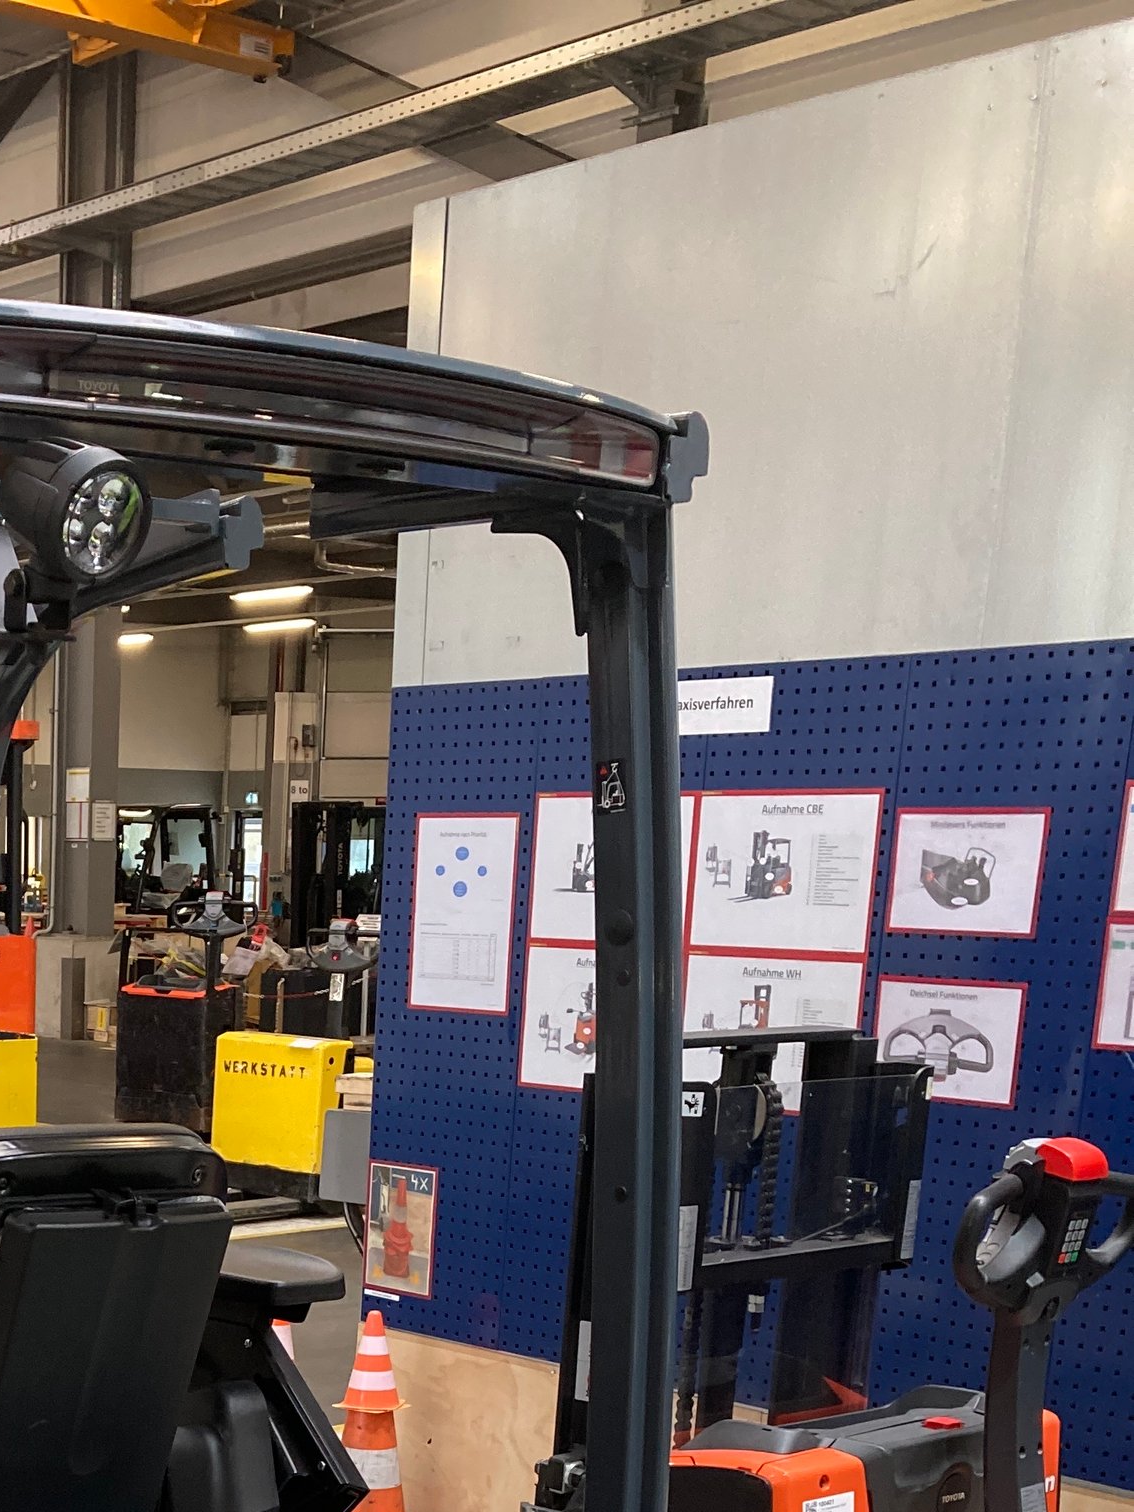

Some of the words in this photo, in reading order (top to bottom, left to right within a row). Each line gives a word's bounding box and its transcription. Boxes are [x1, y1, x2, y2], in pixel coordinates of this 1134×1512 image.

[77, 379, 120, 393] TOYOTA
[298, 785, 308, 795] to
[761, 804, 805, 816] Aufnahme
[806, 803, 824, 815] CBE
[742, 967, 785, 978] Aufnahme
[786, 969, 802, 979] WH
[223, 1060, 306, 1079] WERKSTATT
[941, 1491, 966, 1504] TOYOTA
